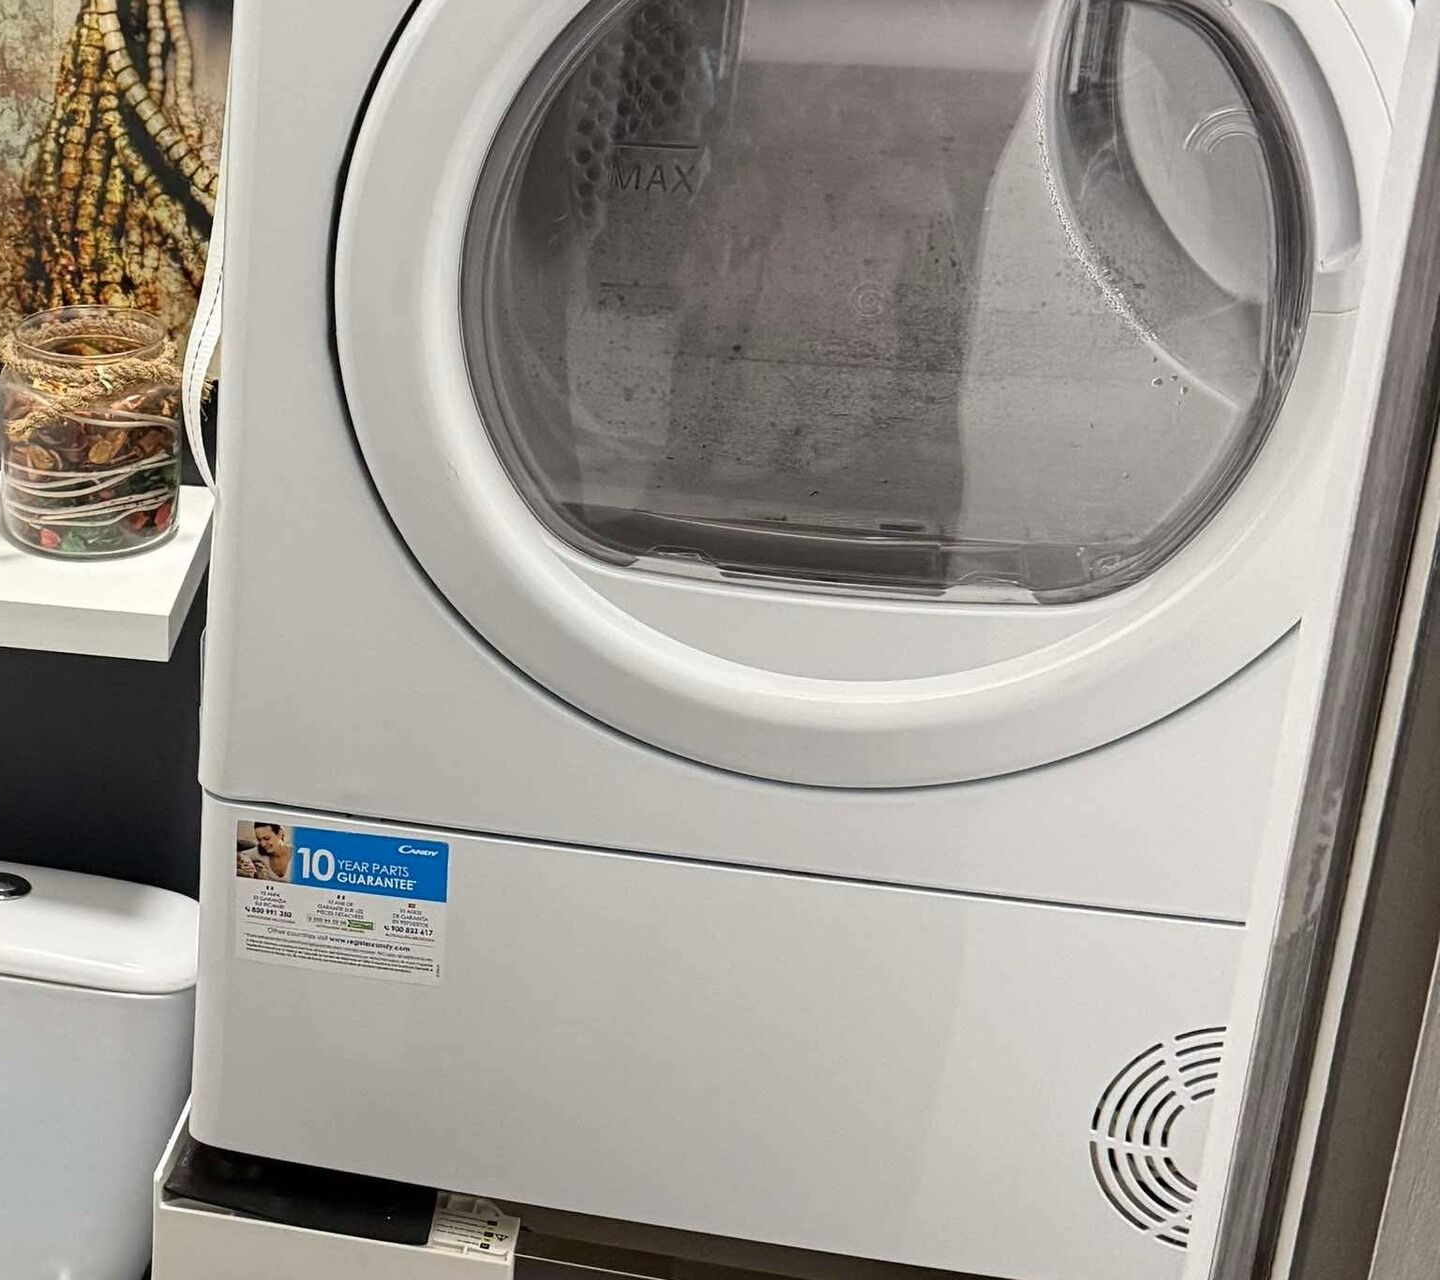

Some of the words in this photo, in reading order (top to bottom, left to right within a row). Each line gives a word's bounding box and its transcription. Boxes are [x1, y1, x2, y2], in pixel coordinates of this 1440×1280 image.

[610, 164, 694, 193] MAX
[398, 845, 439, 857] CANDY
[297, 847, 335, 881] 10
[337, 859, 369, 873] YEAR
[372, 863, 409, 878] PARTS
